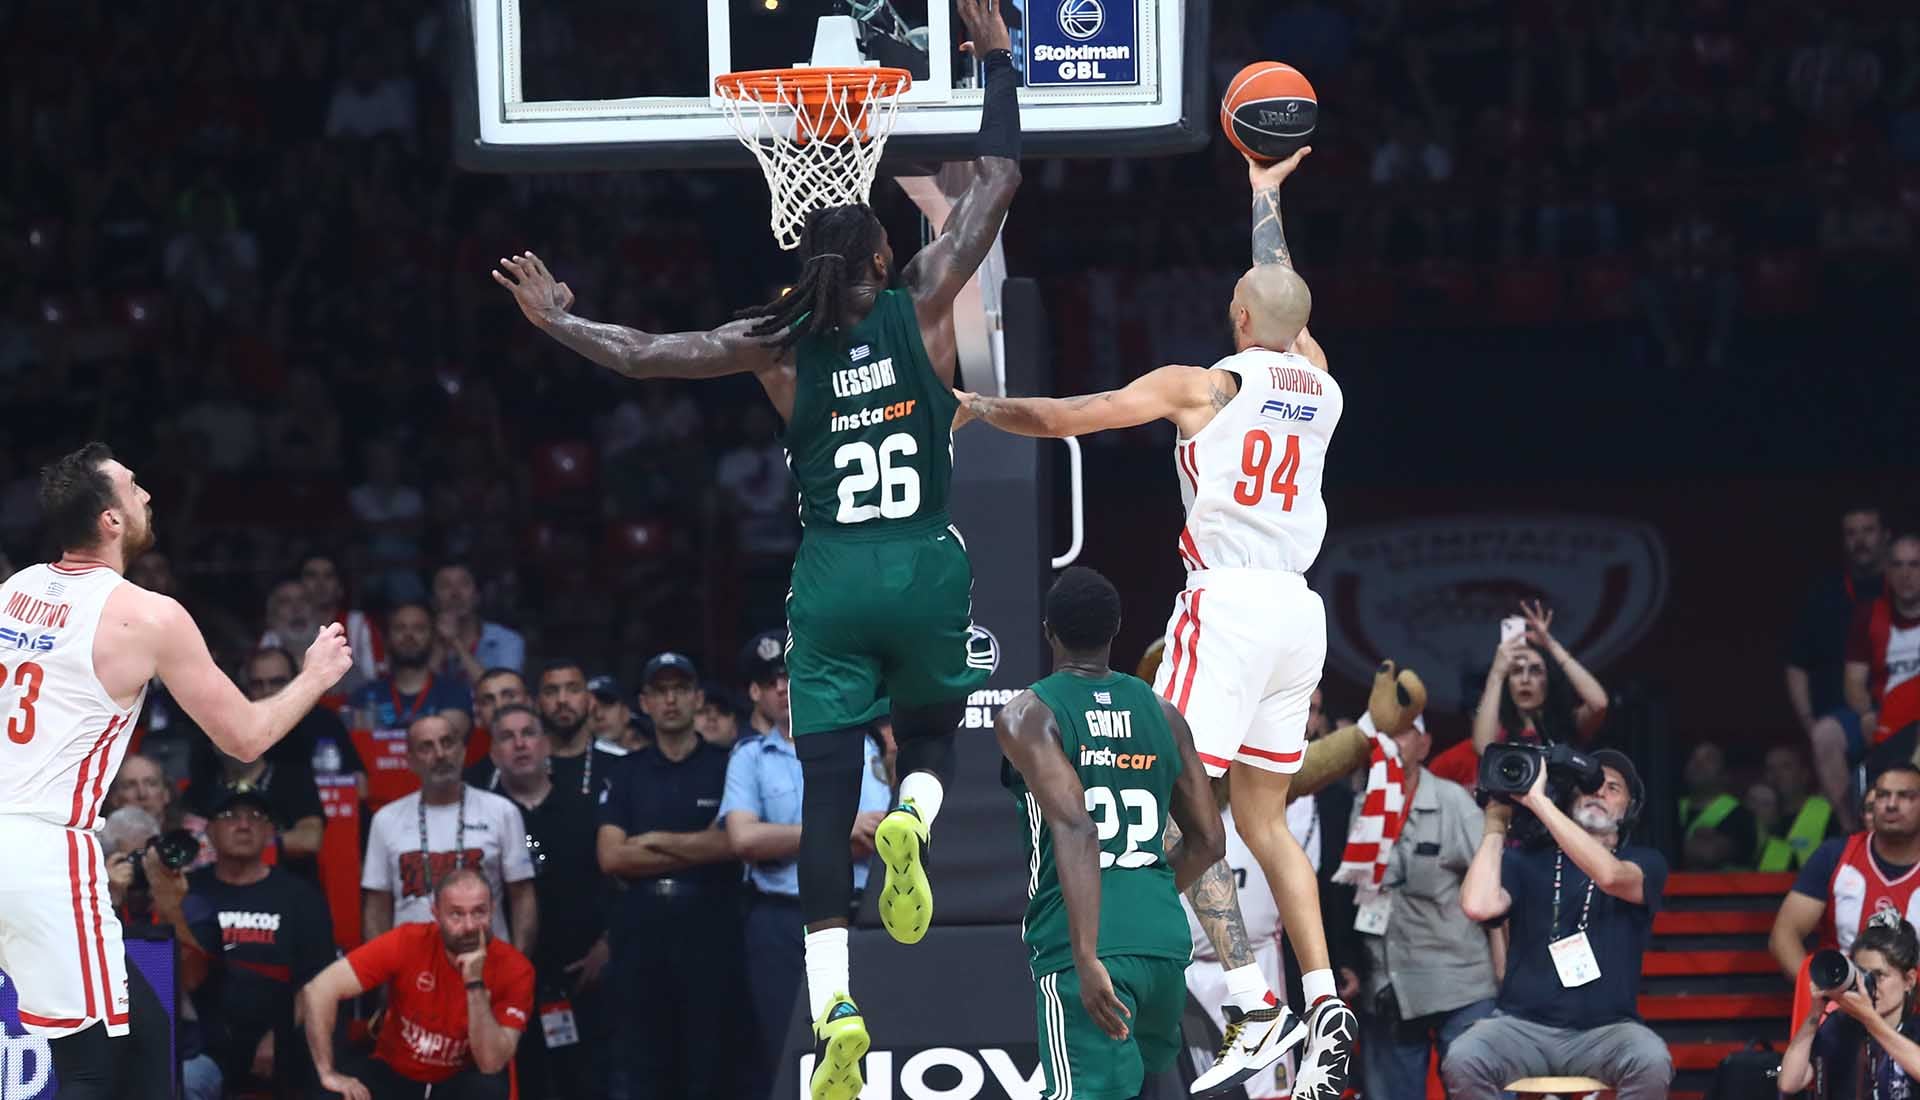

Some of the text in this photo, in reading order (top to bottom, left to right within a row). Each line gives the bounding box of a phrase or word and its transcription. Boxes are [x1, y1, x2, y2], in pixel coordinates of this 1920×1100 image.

[1034, 44, 1130, 61] Stoiximan
[1058, 61, 1107, 80] GBL
[1269, 366, 1322, 396] FOURNIER
[831, 399, 916, 432] instacar
[1260, 400, 1318, 422] FMS
[834, 432, 921, 524] 26
[1233, 429, 1302, 512] 94
[958, 706, 994, 728] BL
[1084, 786, 1159, 868] 22
